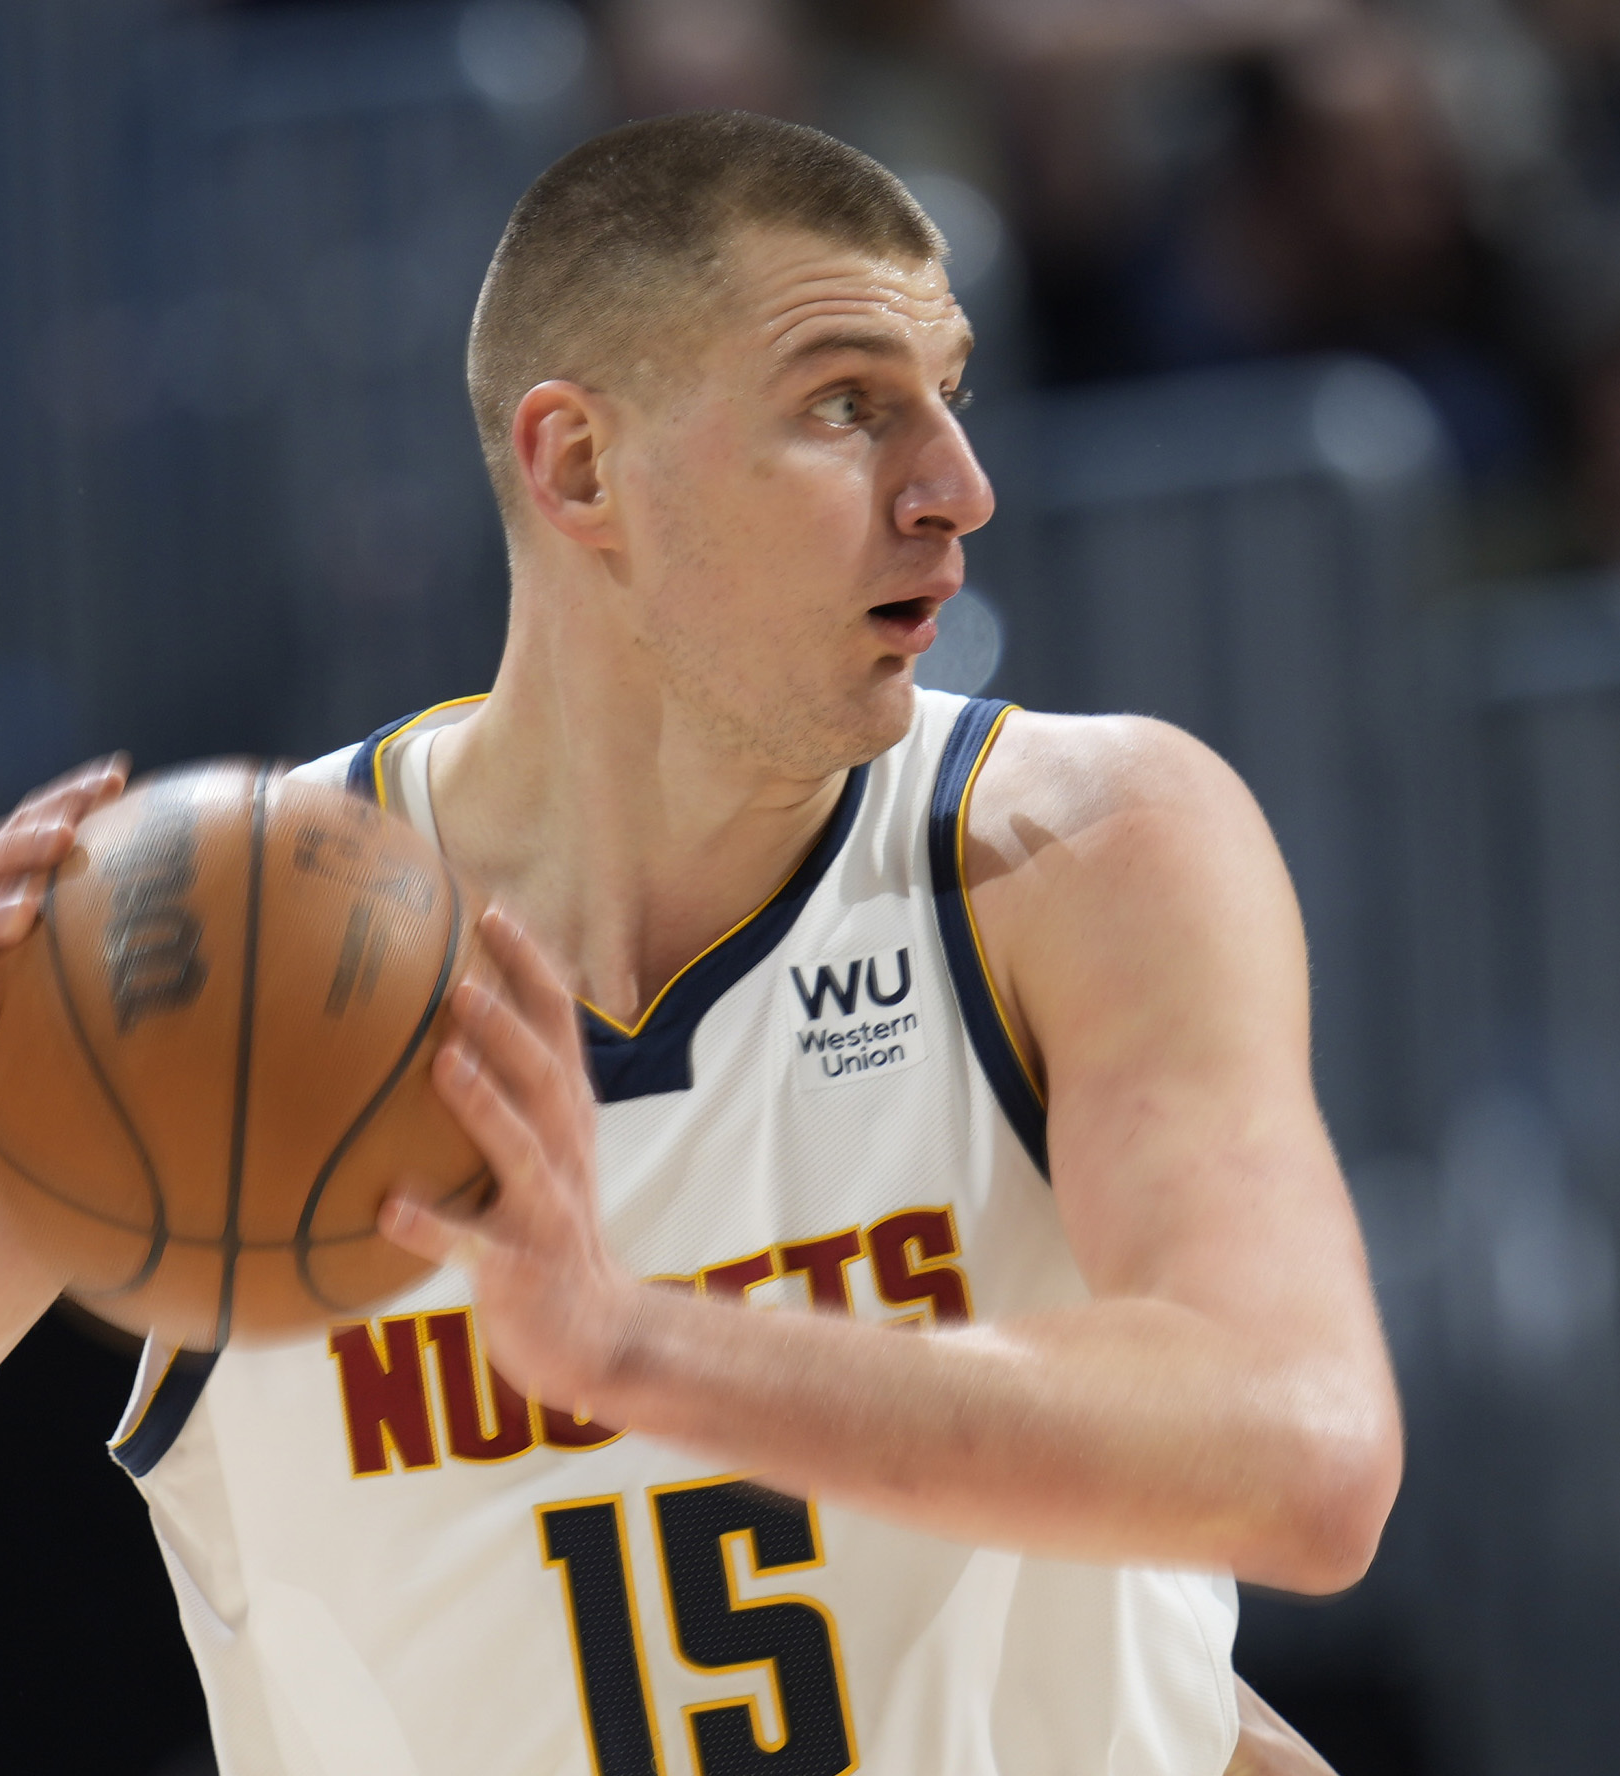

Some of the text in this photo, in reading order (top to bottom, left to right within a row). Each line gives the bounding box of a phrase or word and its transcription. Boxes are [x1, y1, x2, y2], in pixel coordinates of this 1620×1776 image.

[789, 947, 912, 1021] WU
[796, 1013, 918, 1054] Western
[821, 1044, 906, 1078] Union
[327, 1203, 976, 1480] NUTS
